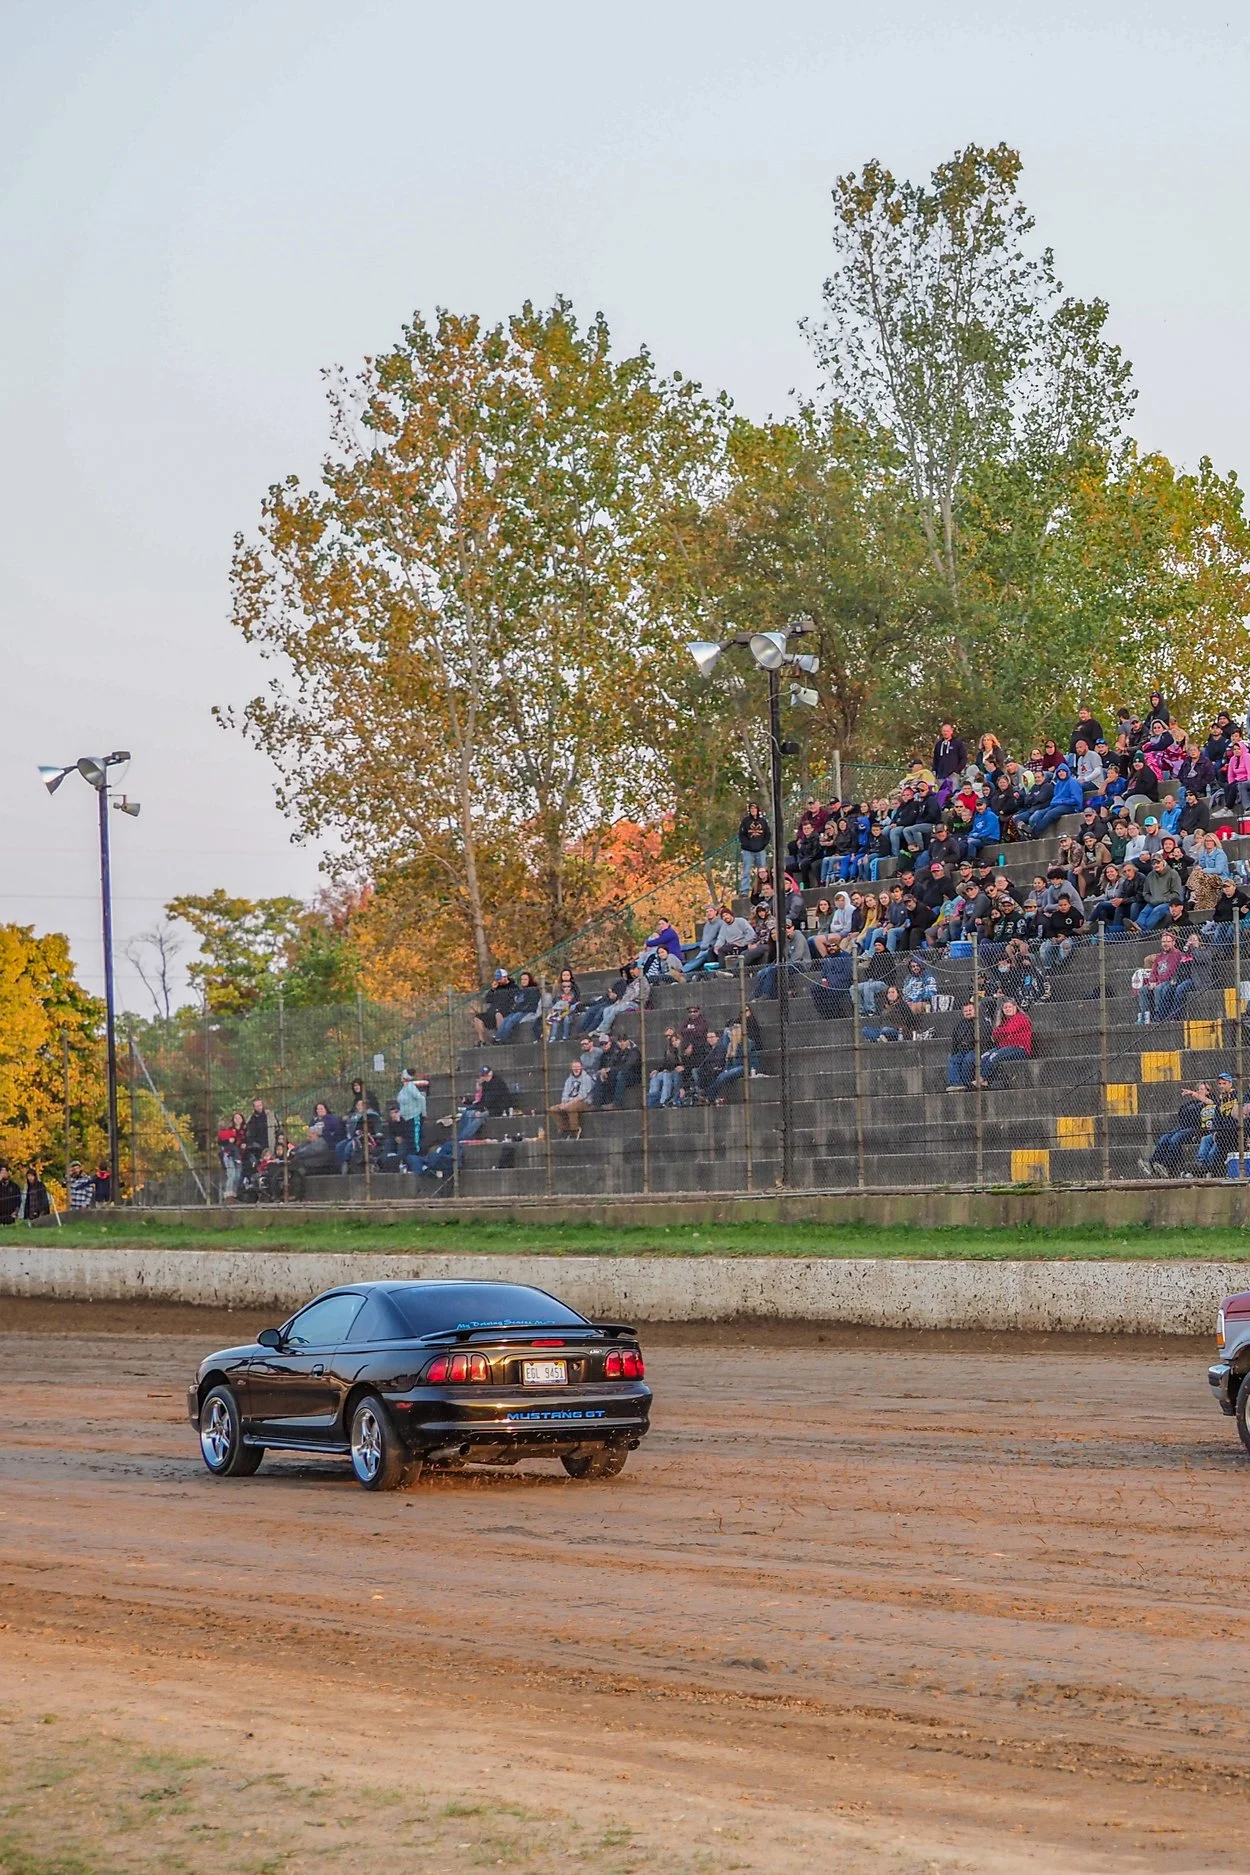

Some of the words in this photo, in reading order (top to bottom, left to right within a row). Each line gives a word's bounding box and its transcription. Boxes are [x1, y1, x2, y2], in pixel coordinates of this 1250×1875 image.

[527, 1367, 540, 1379] EGL
[545, 1367, 564, 1379] 9451
[507, 1411, 582, 1420] MUSTANG
[585, 1410, 606, 1418] GT
